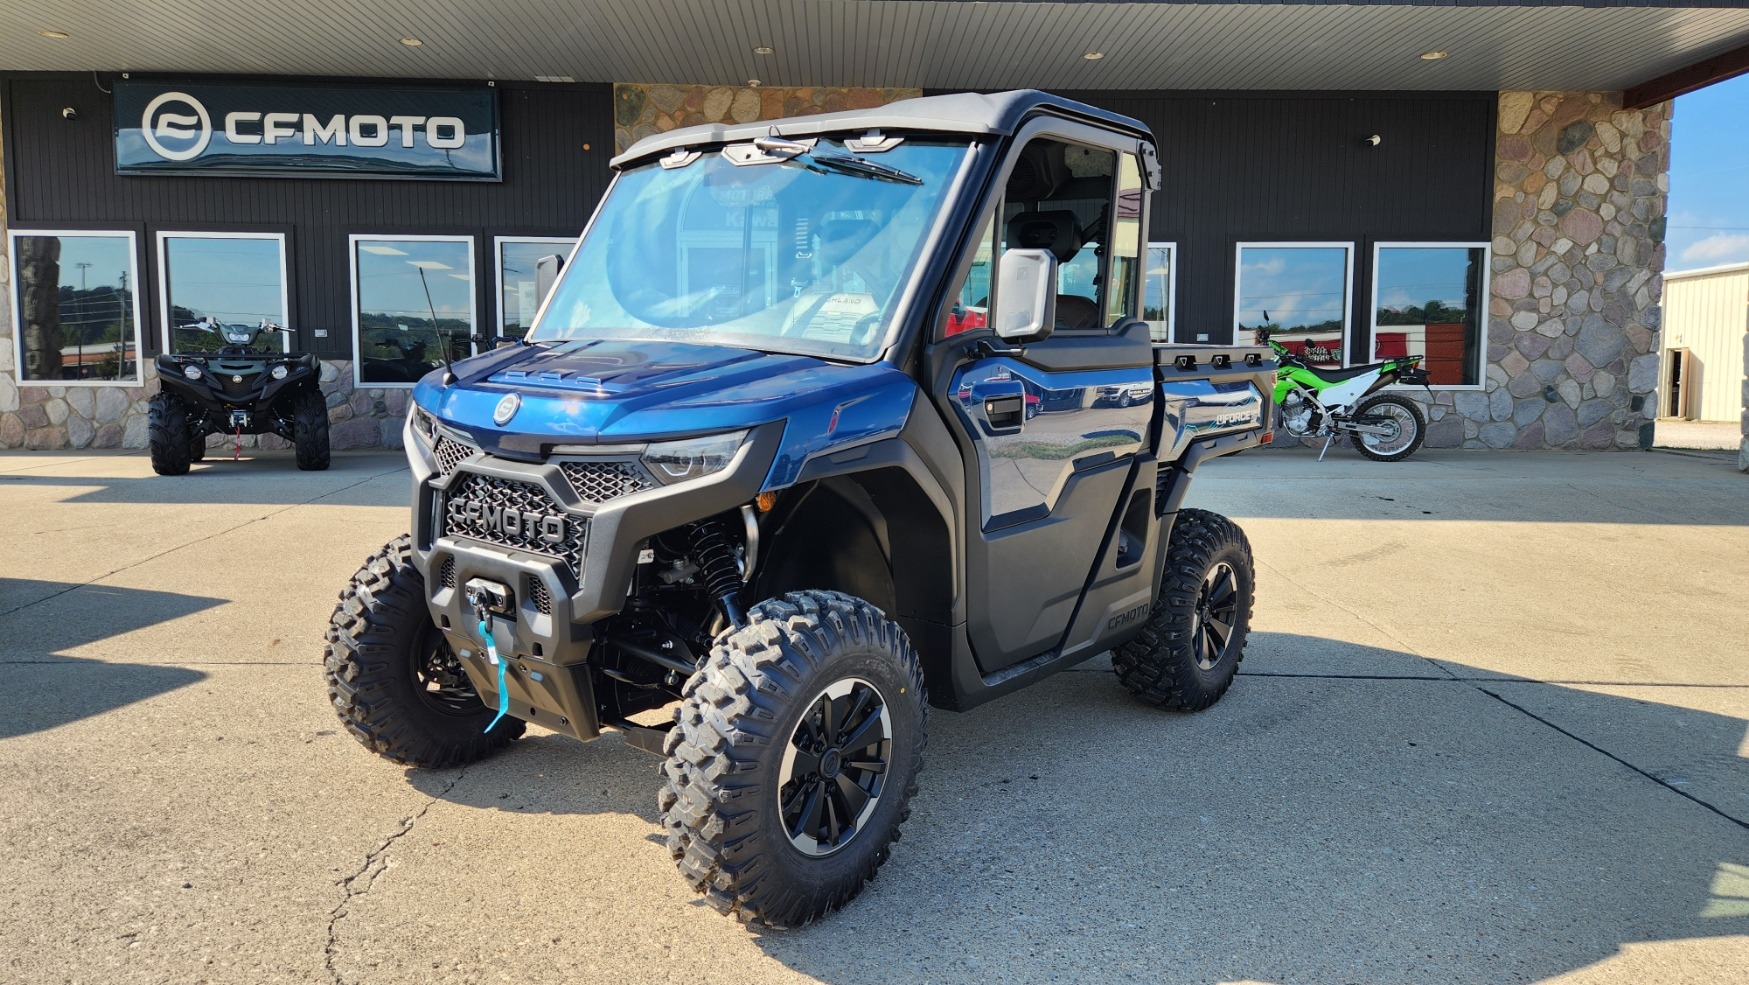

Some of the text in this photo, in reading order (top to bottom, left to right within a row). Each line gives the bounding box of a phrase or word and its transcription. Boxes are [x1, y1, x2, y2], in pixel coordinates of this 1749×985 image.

[225, 111, 466, 149] CFMOTO
[452, 497, 565, 543] CFMOTO
[1108, 603, 1149, 630] CFMOTO
